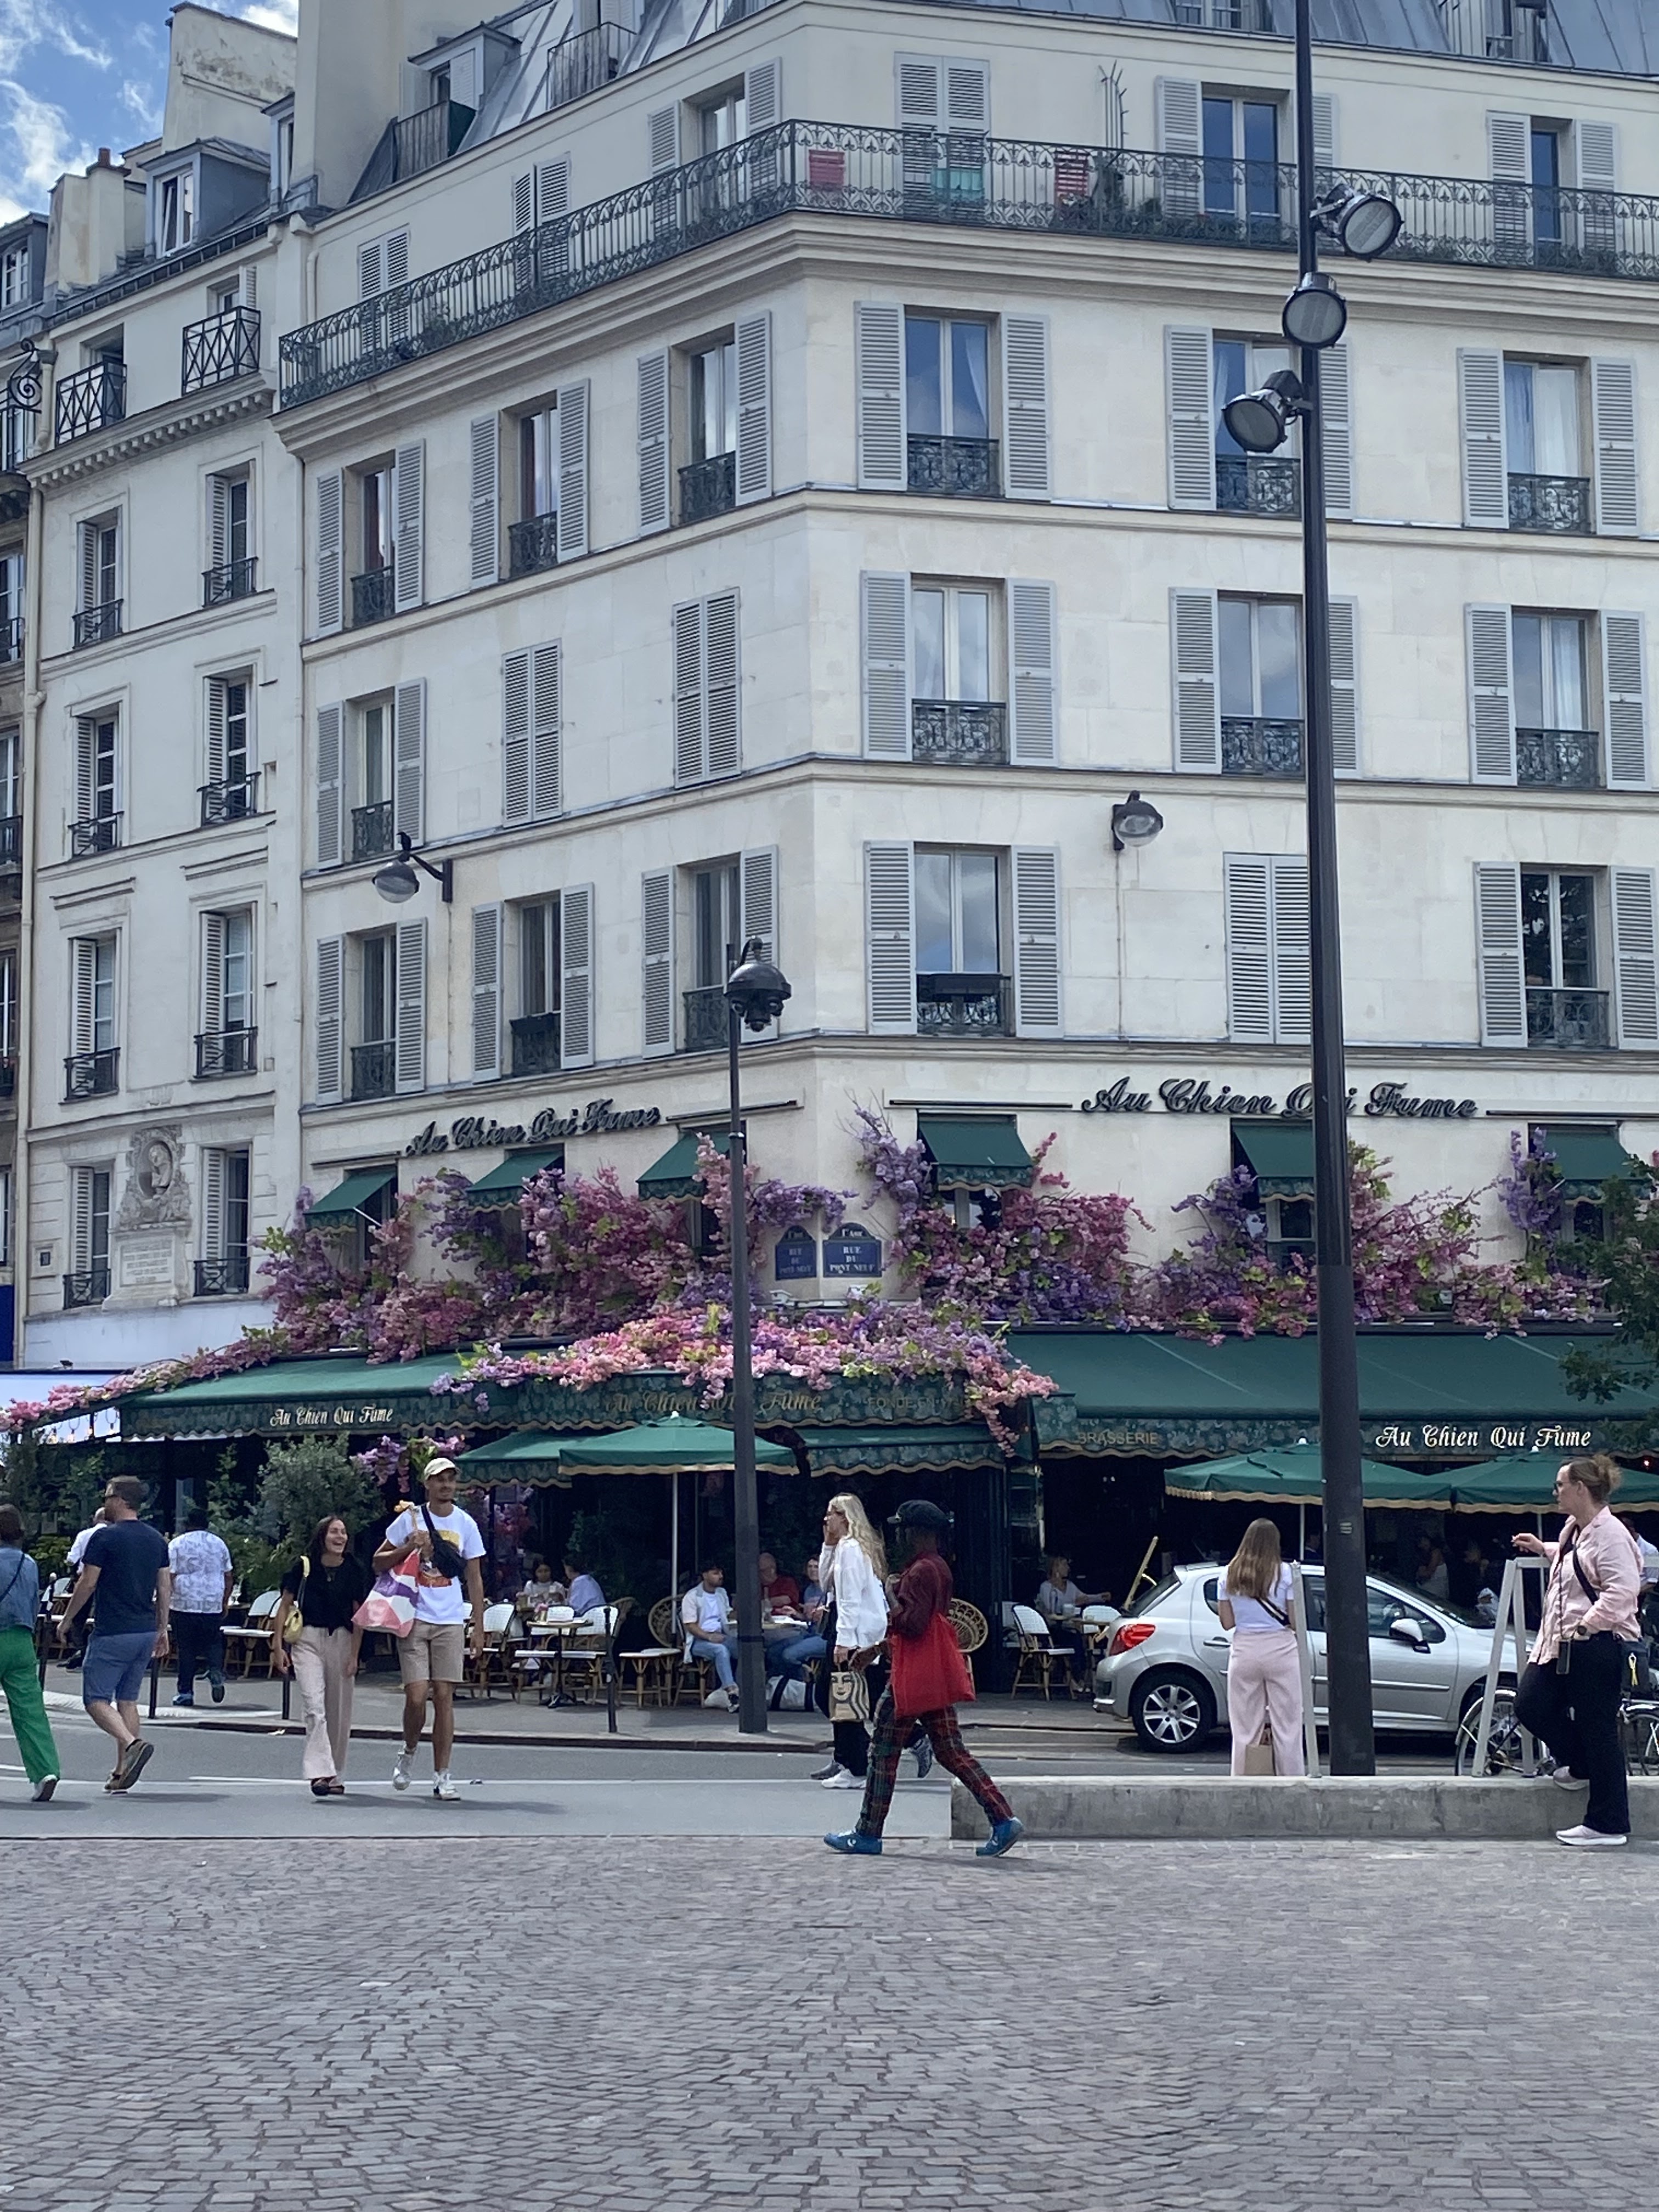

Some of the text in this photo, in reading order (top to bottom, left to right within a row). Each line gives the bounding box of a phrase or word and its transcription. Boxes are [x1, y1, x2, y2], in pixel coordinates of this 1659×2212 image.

[1081, 1076, 1477, 1118] Au Chien Qi Fume
[406, 1098, 660, 1156] Au Chien Qui Fume
[843, 1246, 862, 1254] RUE
[759, 1391, 821, 1413] Fume
[270, 1404, 394, 1427] Au Chien Qui Fume
[1078, 1432, 1158, 1444] BRASSERIE
[1375, 1424, 1591, 1448] Au Chien Qui Fume
